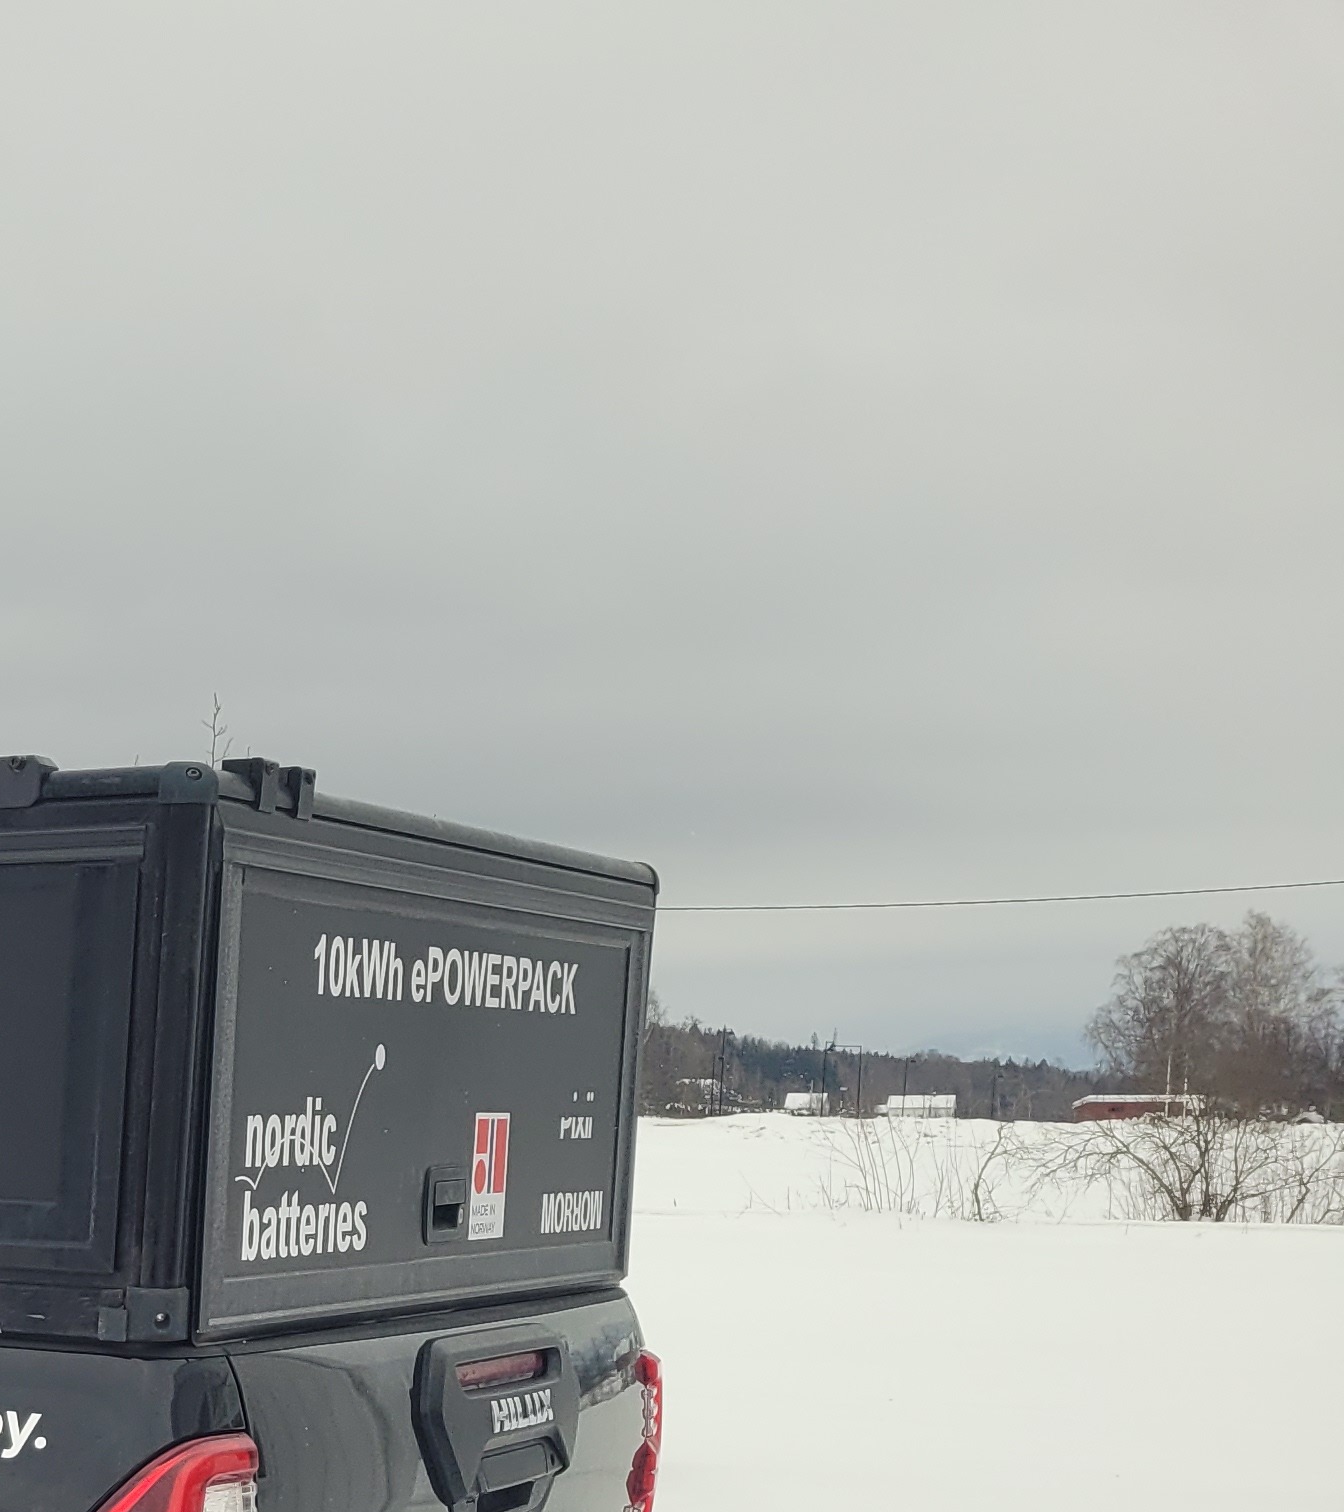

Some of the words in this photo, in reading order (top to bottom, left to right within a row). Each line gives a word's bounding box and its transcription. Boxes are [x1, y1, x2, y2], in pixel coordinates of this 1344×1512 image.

[313, 933, 404, 1001] 10kWh
[411, 946, 579, 1015] ePOWERPACK
[244, 1096, 337, 1168] nordic
[240, 1191, 368, 1262] batteries
[470, 1221, 496, 1235] NORWAY
[472, 1204, 489, 1216] MADE
[490, 1203, 496, 1215] IN
[490, 1388, 555, 1435] HILUX
